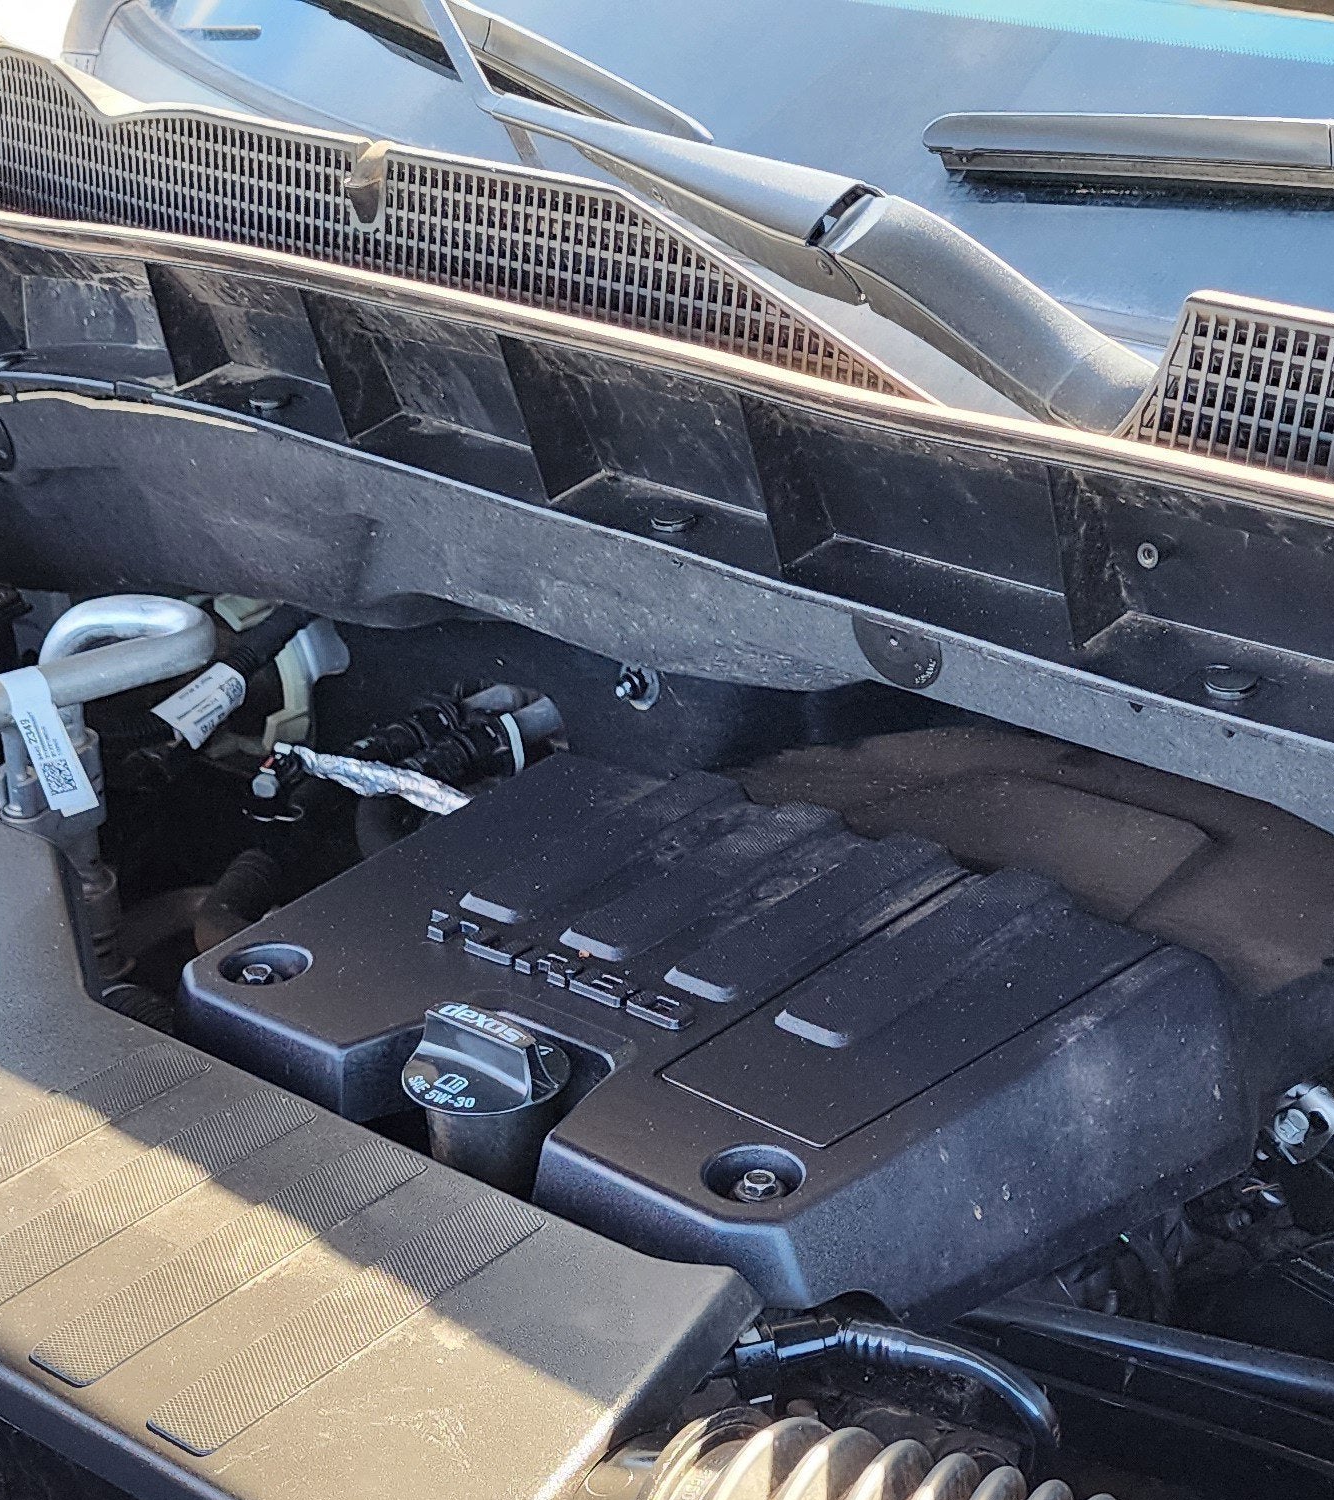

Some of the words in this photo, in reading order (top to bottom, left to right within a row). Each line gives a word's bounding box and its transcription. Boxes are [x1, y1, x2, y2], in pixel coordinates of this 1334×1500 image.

[438, 1003, 522, 1043] dexos
[408, 1075, 430, 1094] SAE
[424, 1089, 476, 1108] 5W-30
